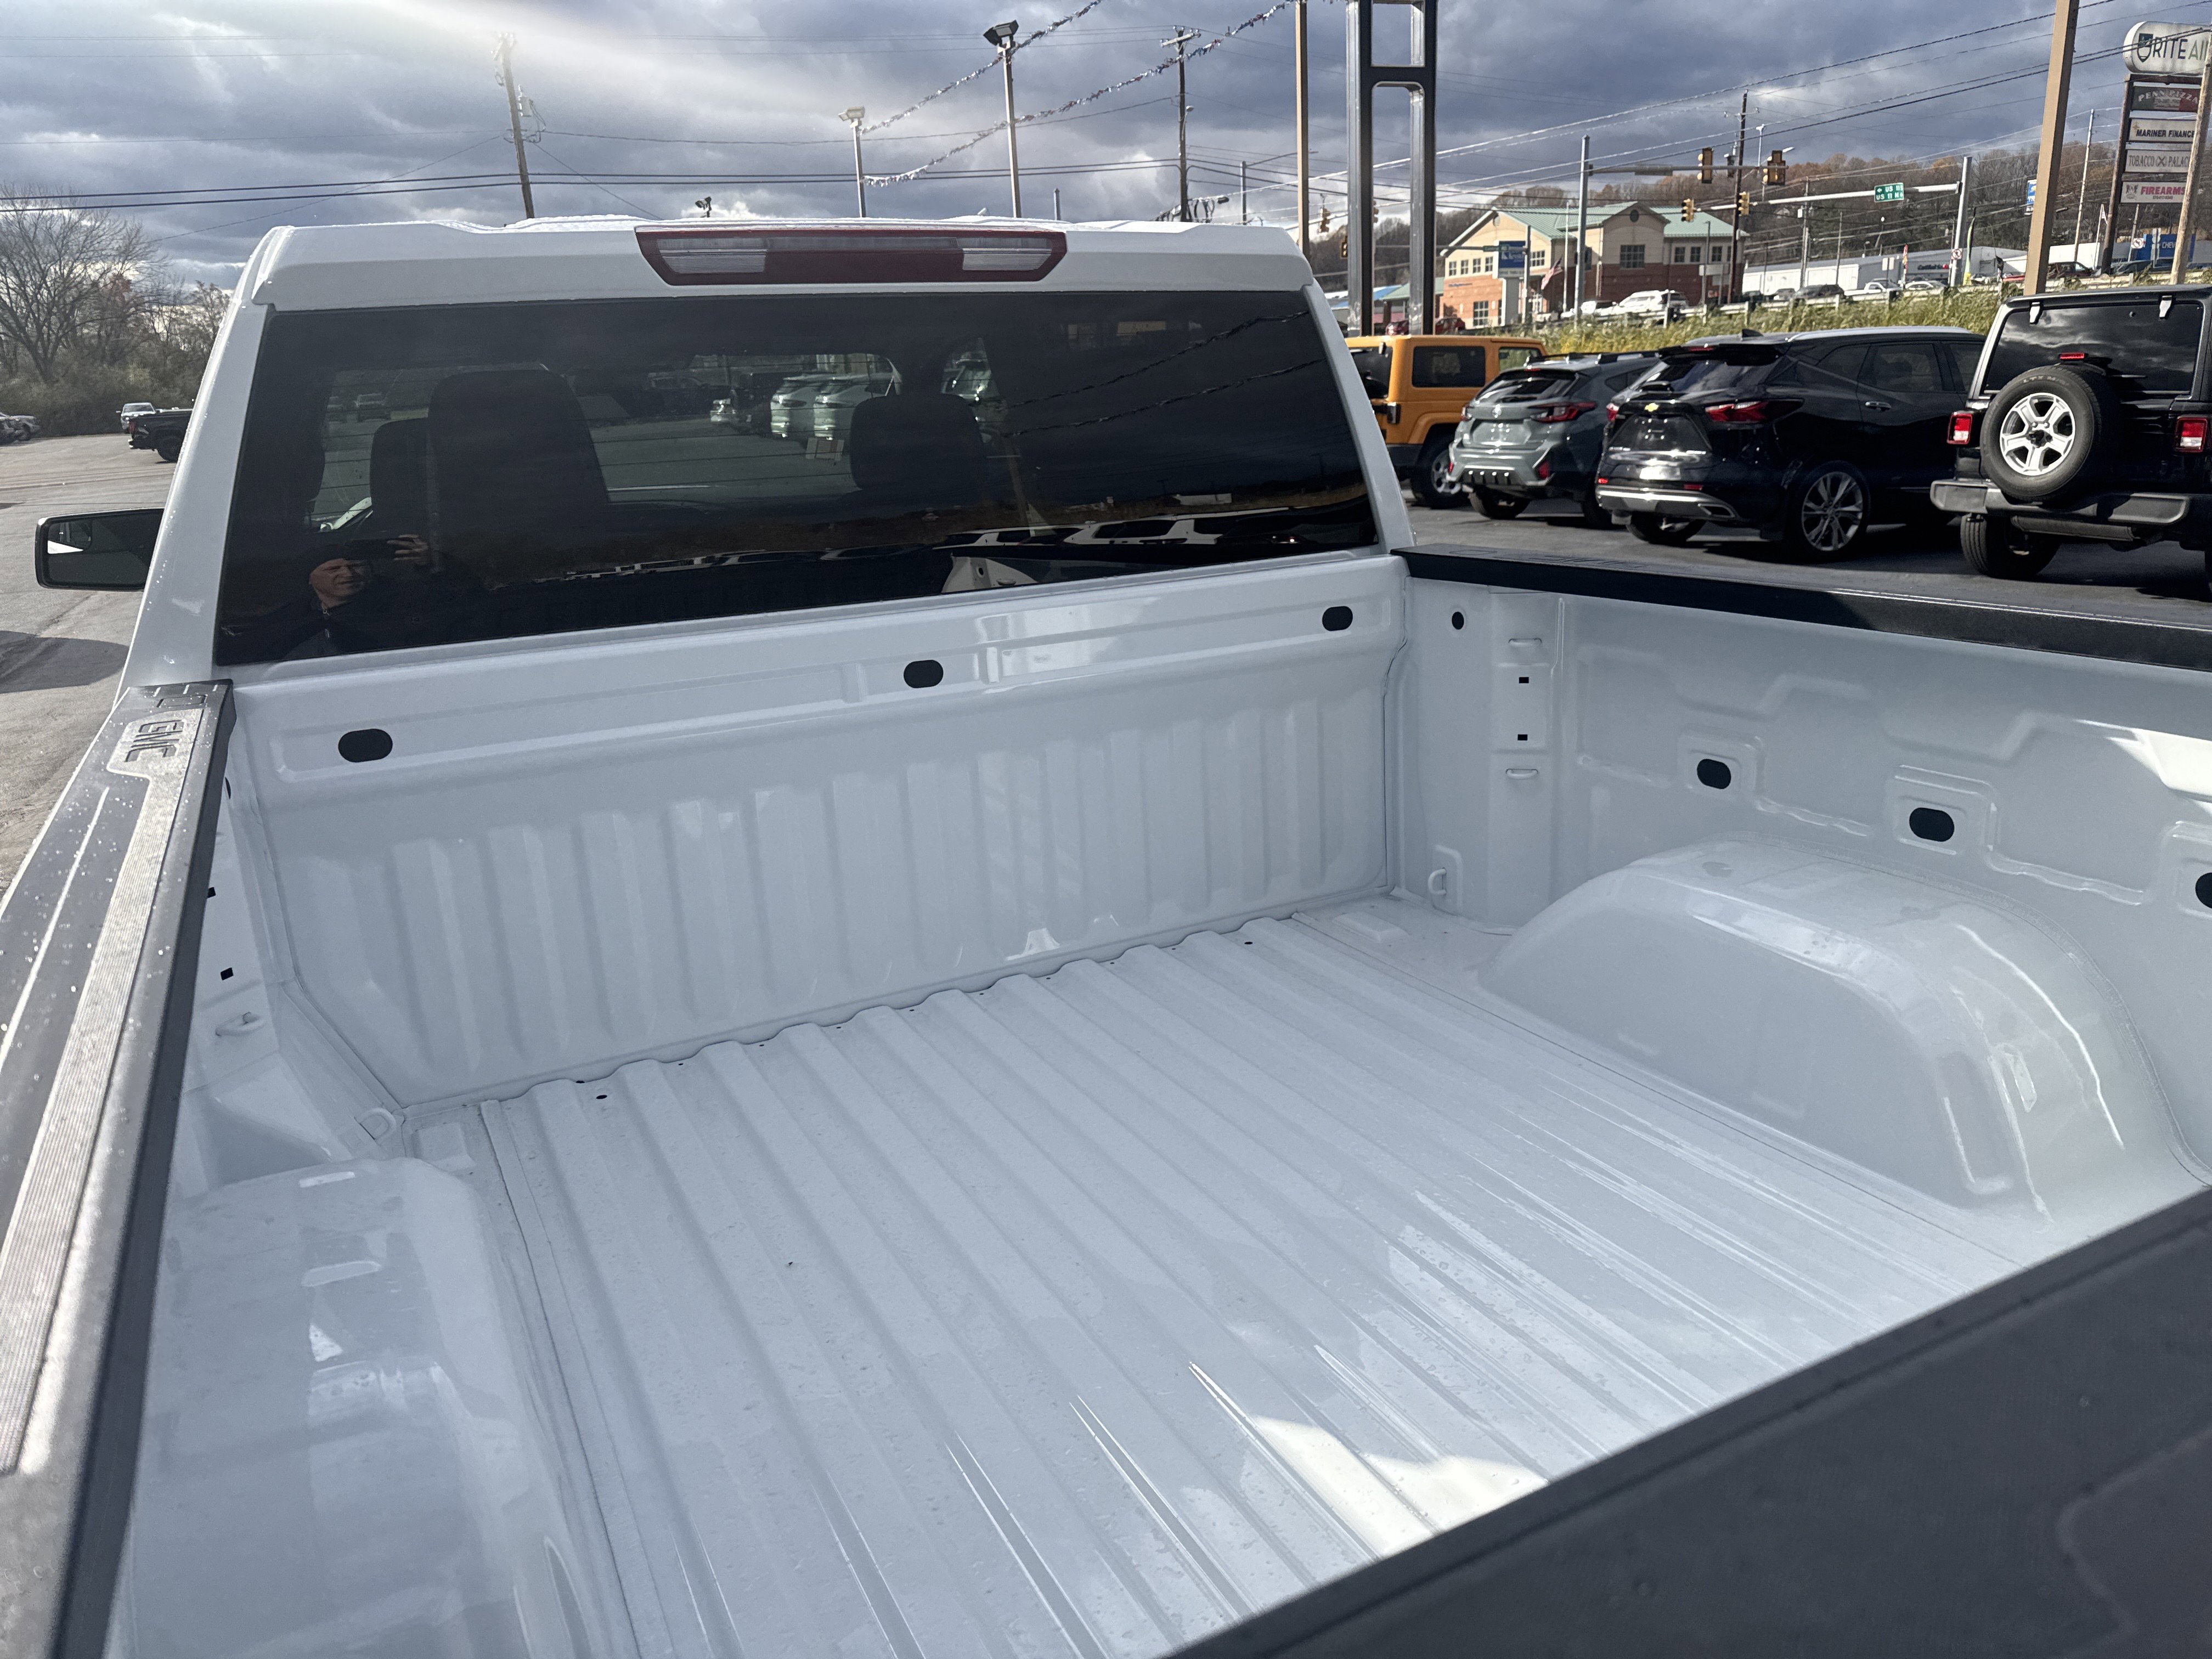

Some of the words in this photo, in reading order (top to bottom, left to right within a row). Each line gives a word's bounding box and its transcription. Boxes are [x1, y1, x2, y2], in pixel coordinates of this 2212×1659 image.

[2153, 37, 2188, 59] RITE
[2138, 89, 2165, 101] PENN
[2168, 89, 2198, 103] PIZZA
[2136, 129, 2166, 137] MARINER
[2129, 155, 2154, 167] TOBACCO
[124, 719, 184, 763] GMC
